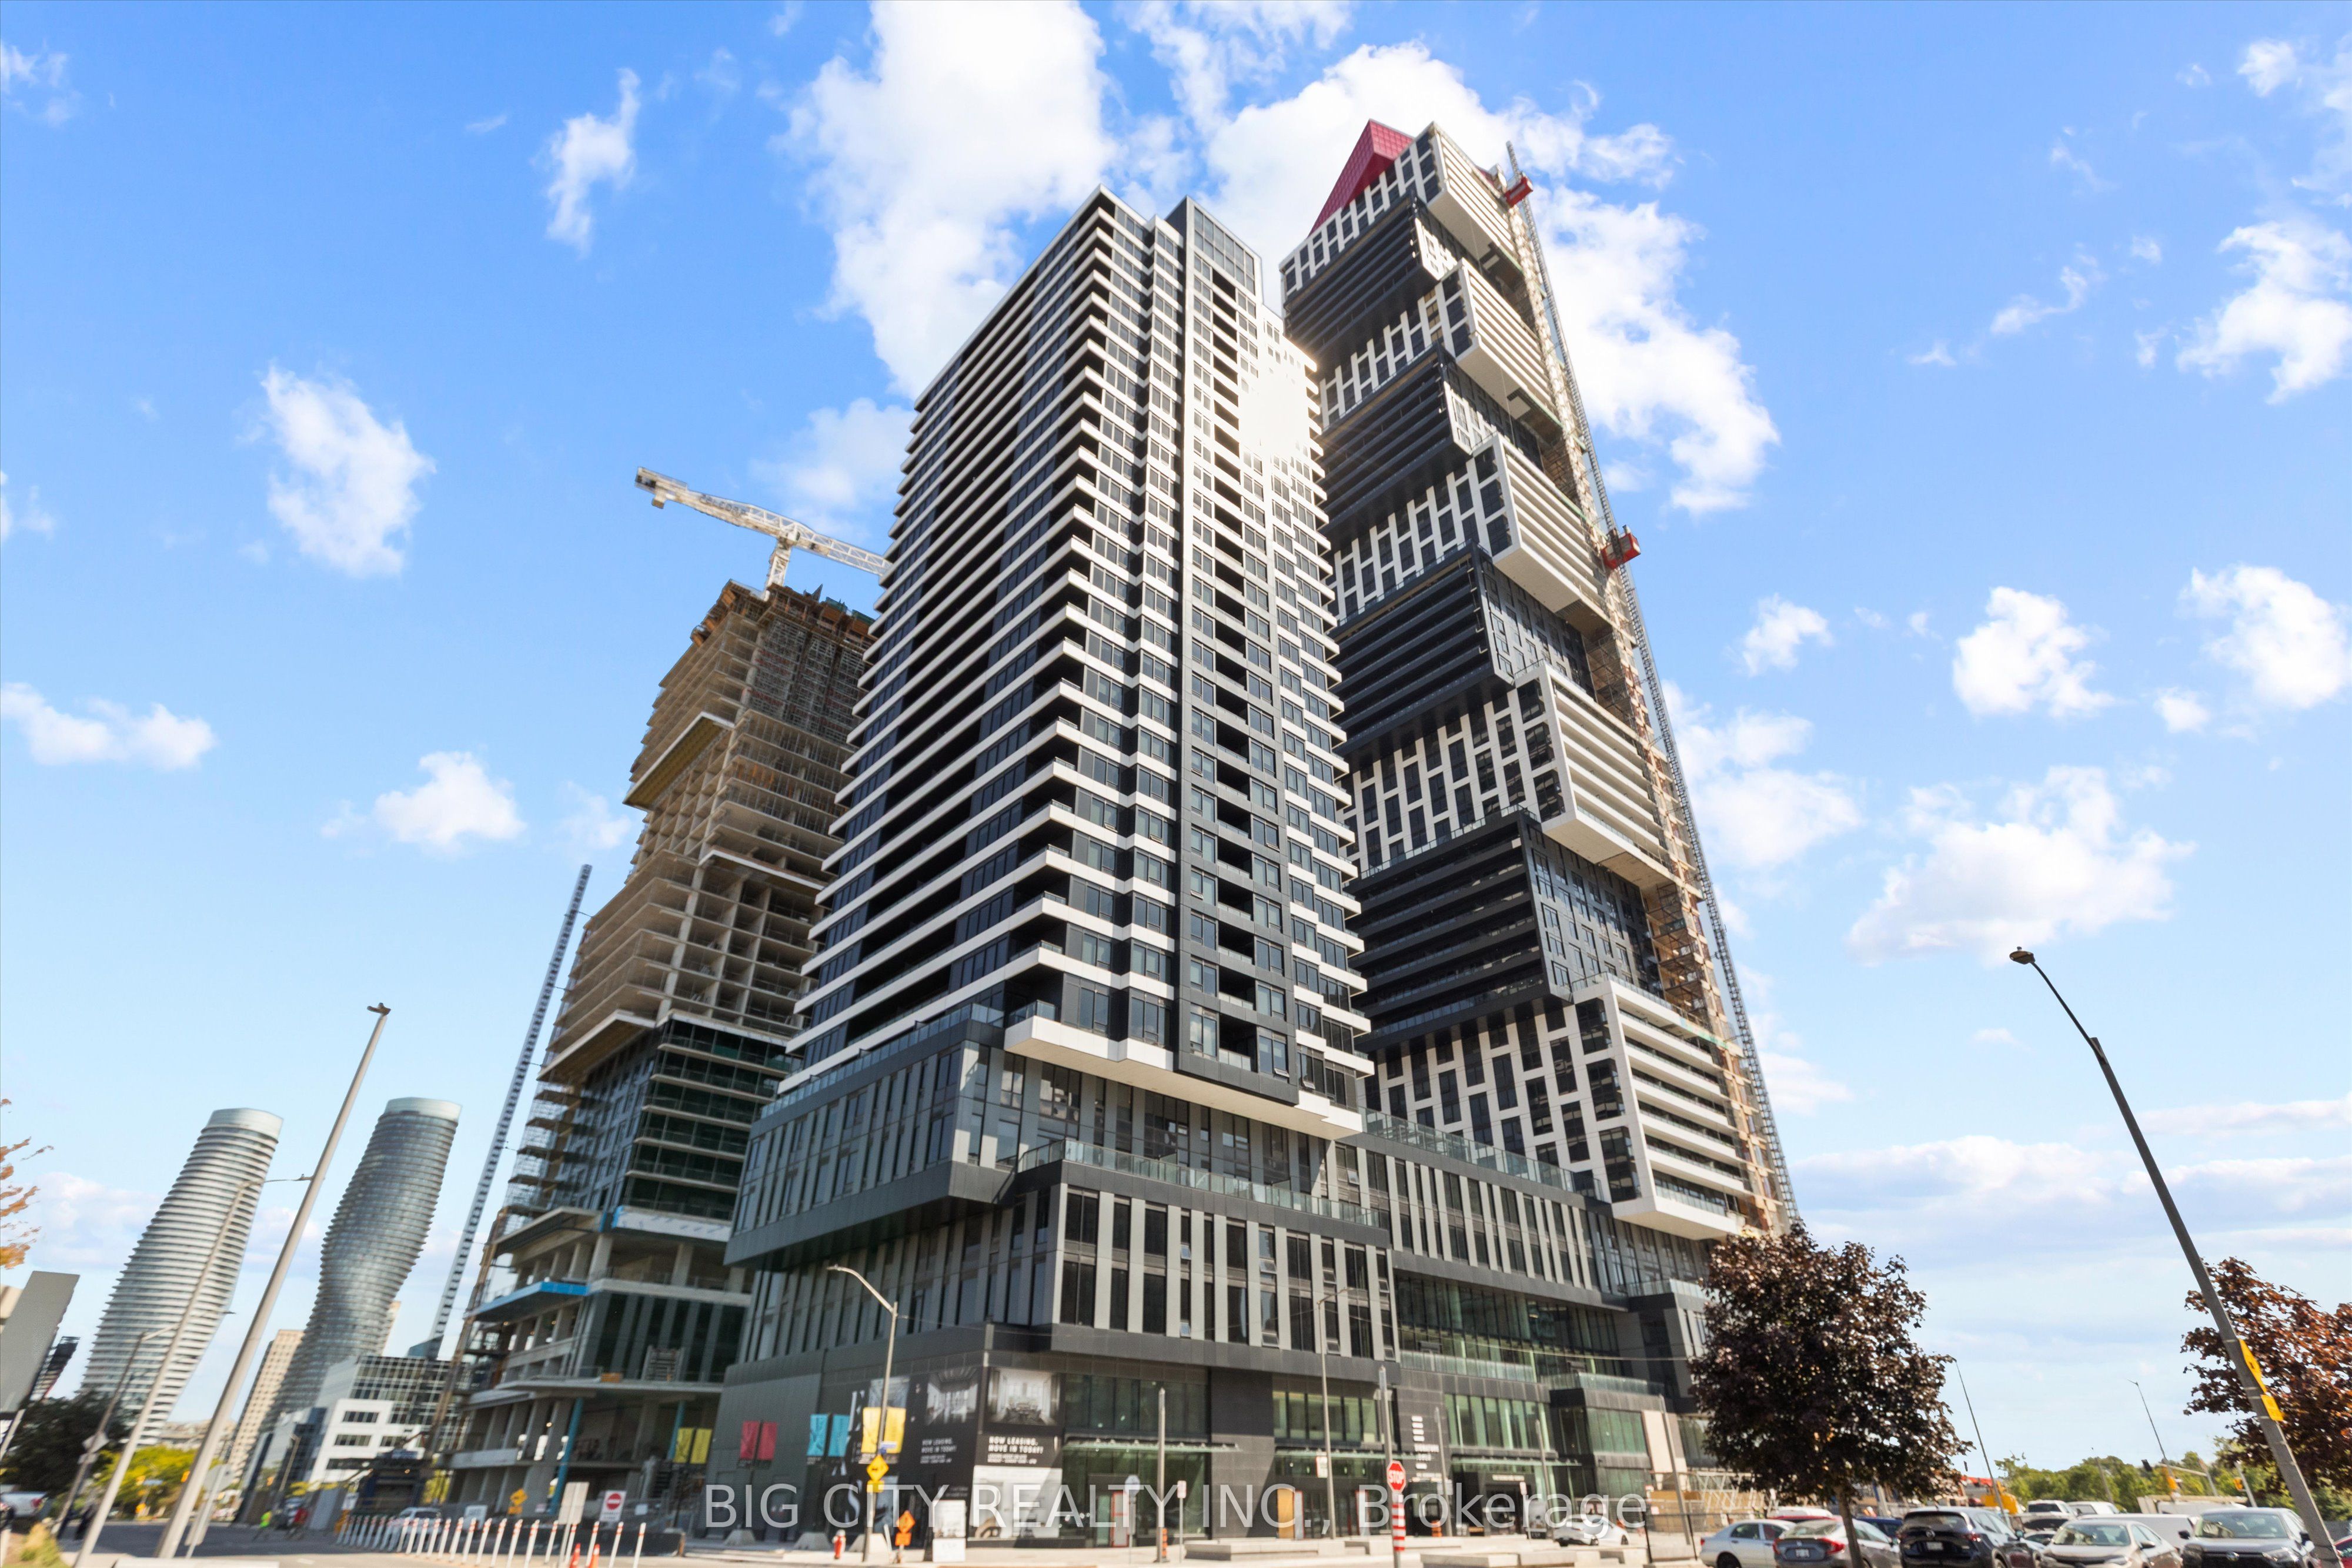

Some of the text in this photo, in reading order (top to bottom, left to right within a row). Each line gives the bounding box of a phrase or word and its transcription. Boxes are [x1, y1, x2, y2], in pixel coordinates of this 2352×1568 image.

[989, 1436, 1038, 1446] NOW LEASING.
[988, 1444, 1008, 1452] MOVE
[1019, 1445, 1044, 1454] TODAY!
[1388, 1470, 1405, 1484] STOP
